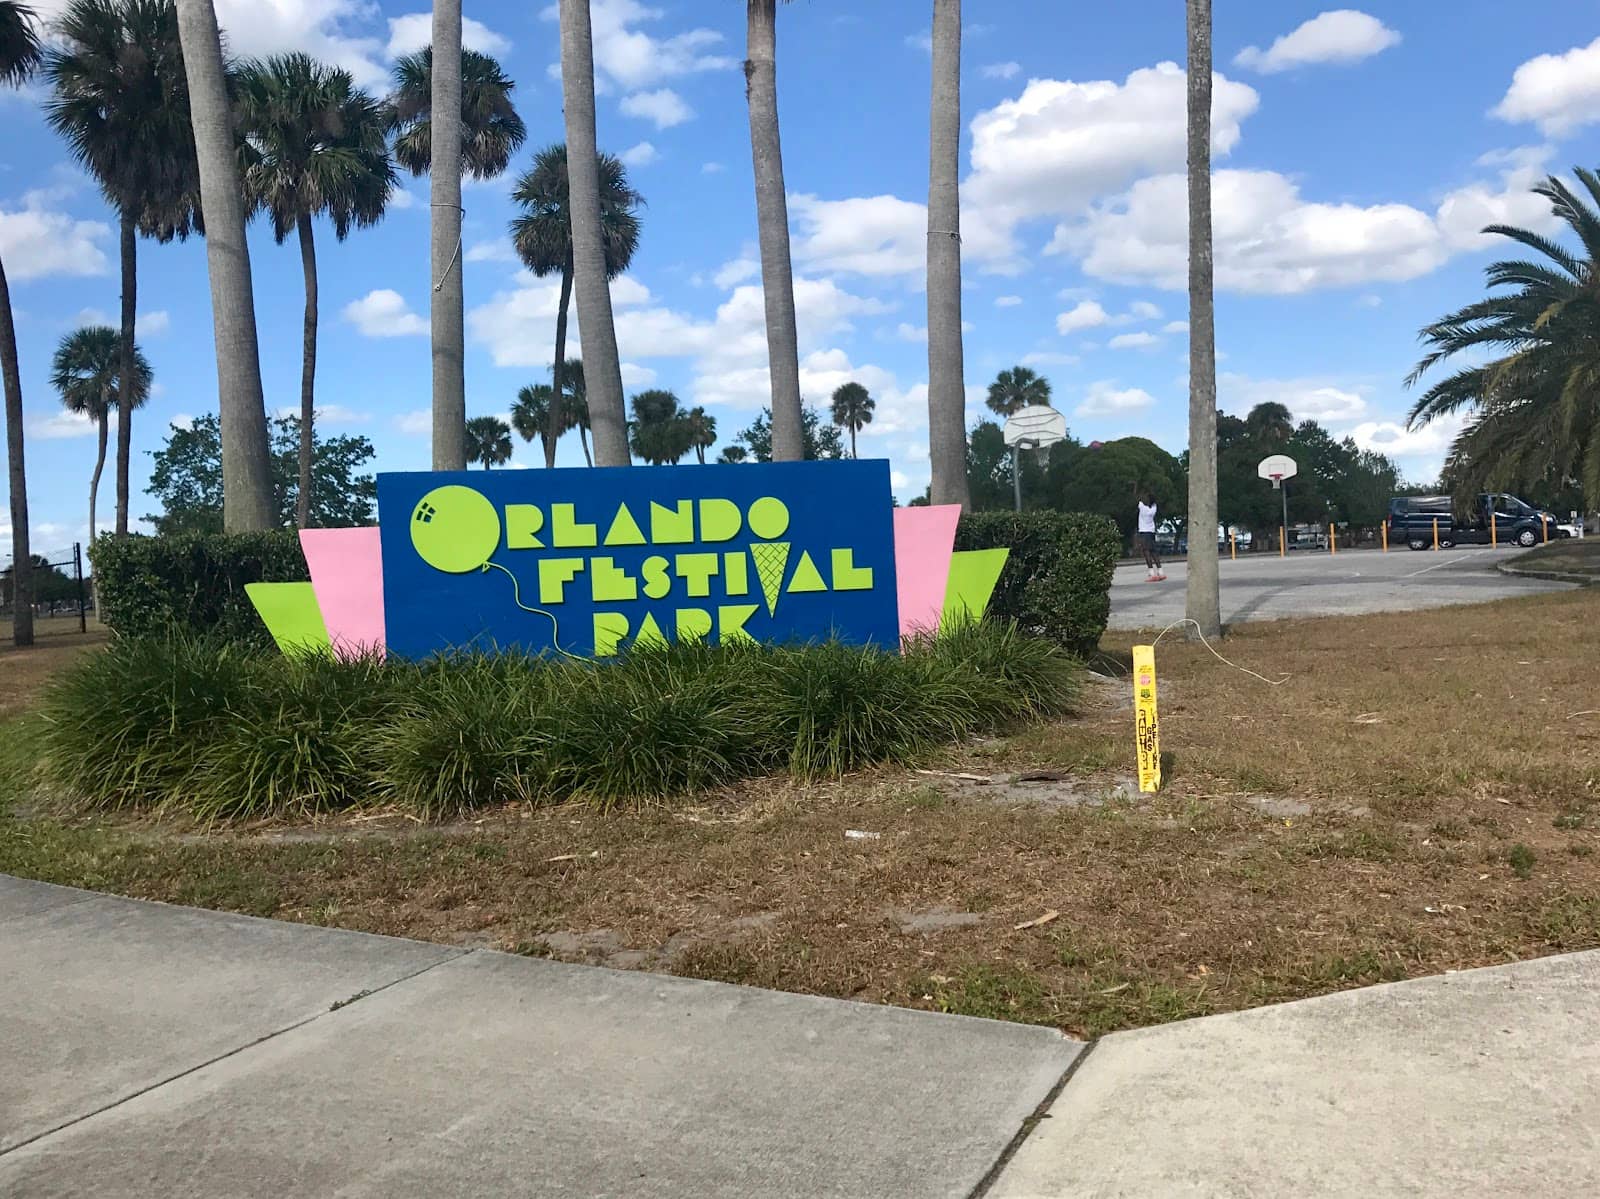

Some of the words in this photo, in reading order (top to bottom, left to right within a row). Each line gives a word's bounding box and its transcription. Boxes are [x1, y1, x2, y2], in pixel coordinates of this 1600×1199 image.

[410, 485, 791, 574] ORLANDO
[538, 542, 874, 618] FESTIVAL
[593, 604, 763, 656] PARK
